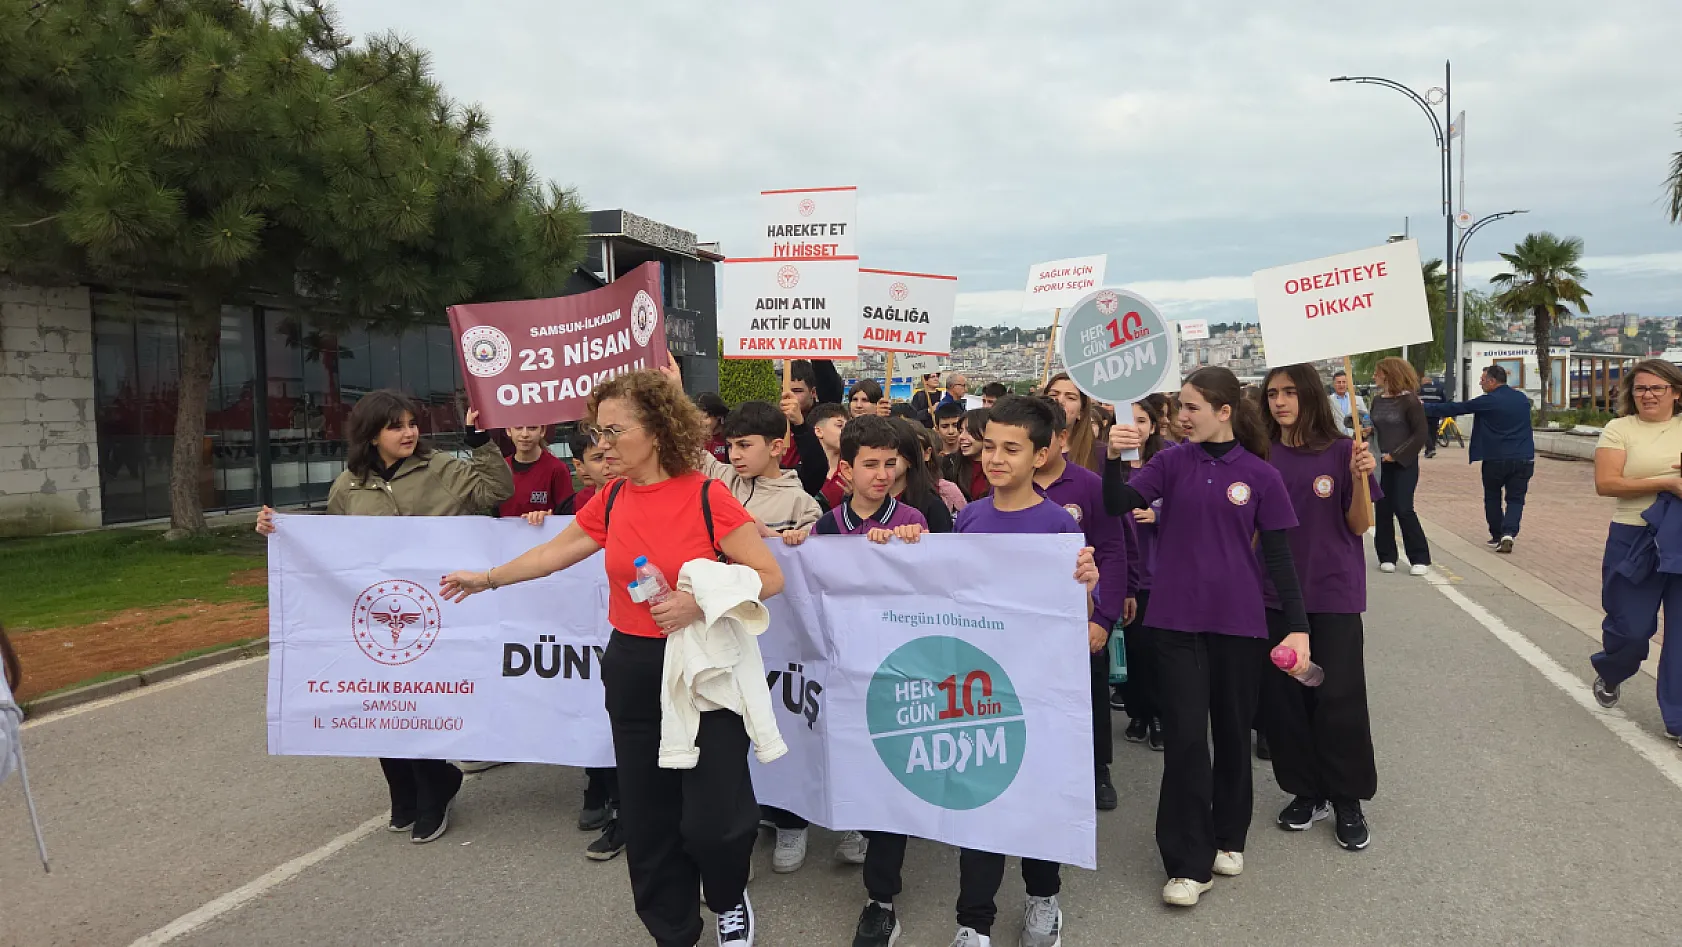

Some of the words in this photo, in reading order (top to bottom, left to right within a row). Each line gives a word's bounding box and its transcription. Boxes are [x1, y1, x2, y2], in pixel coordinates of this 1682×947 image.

[767, 224, 827, 238] HAREKET
[829, 223, 847, 236] ET
[773, 242, 791, 257] İYİ
[792, 241, 839, 257] HİSSET
[1039, 267, 1071, 280] SAĞLIK
[1072, 265, 1093, 277] İÇİN
[1284, 261, 1388, 295] OBEZİTEYE
[1033, 281, 1064, 294] SPORU
[1066, 279, 1095, 291] SEÇİN
[755, 297, 789, 310] ADIM
[792, 297, 826, 310] ATIN
[1305, 292, 1375, 319] DİKKAT
[529, 308, 622, 337] SAMSUN-İLKADIM
[750, 315, 790, 331] AKTİF
[793, 317, 831, 331] OLUN
[862, 304, 930, 324] SAĞLIĞA
[863, 327, 902, 343] ADIM
[904, 331, 928, 345] AT
[1080, 324, 1105, 343] HER
[1105, 311, 1143, 349] 10
[1133, 327, 1150, 339] bin
[518, 347, 555, 371] 23
[564, 327, 631, 367] NİSAN
[739, 337, 775, 351] FARK
[779, 337, 842, 351] YARATIN
[1083, 339, 1107, 357] GÜN
[881, 610, 1006, 631] #hergün10binadım
[307, 680, 333, 694] T.C.
[337, 678, 390, 694] SAĞLIK
[393, 678, 475, 694] BAKANLIĞI
[895, 678, 936, 702] HER
[937, 669, 993, 720] 10
[977, 699, 1001, 716] bin
[362, 699, 417, 712] SAMSUN
[896, 701, 937, 726] GÜN
[313, 715, 325, 729] İL
[331, 715, 377, 730] SAĞLIK
[379, 715, 464, 731] MÜDÜRLÜĞÜ
